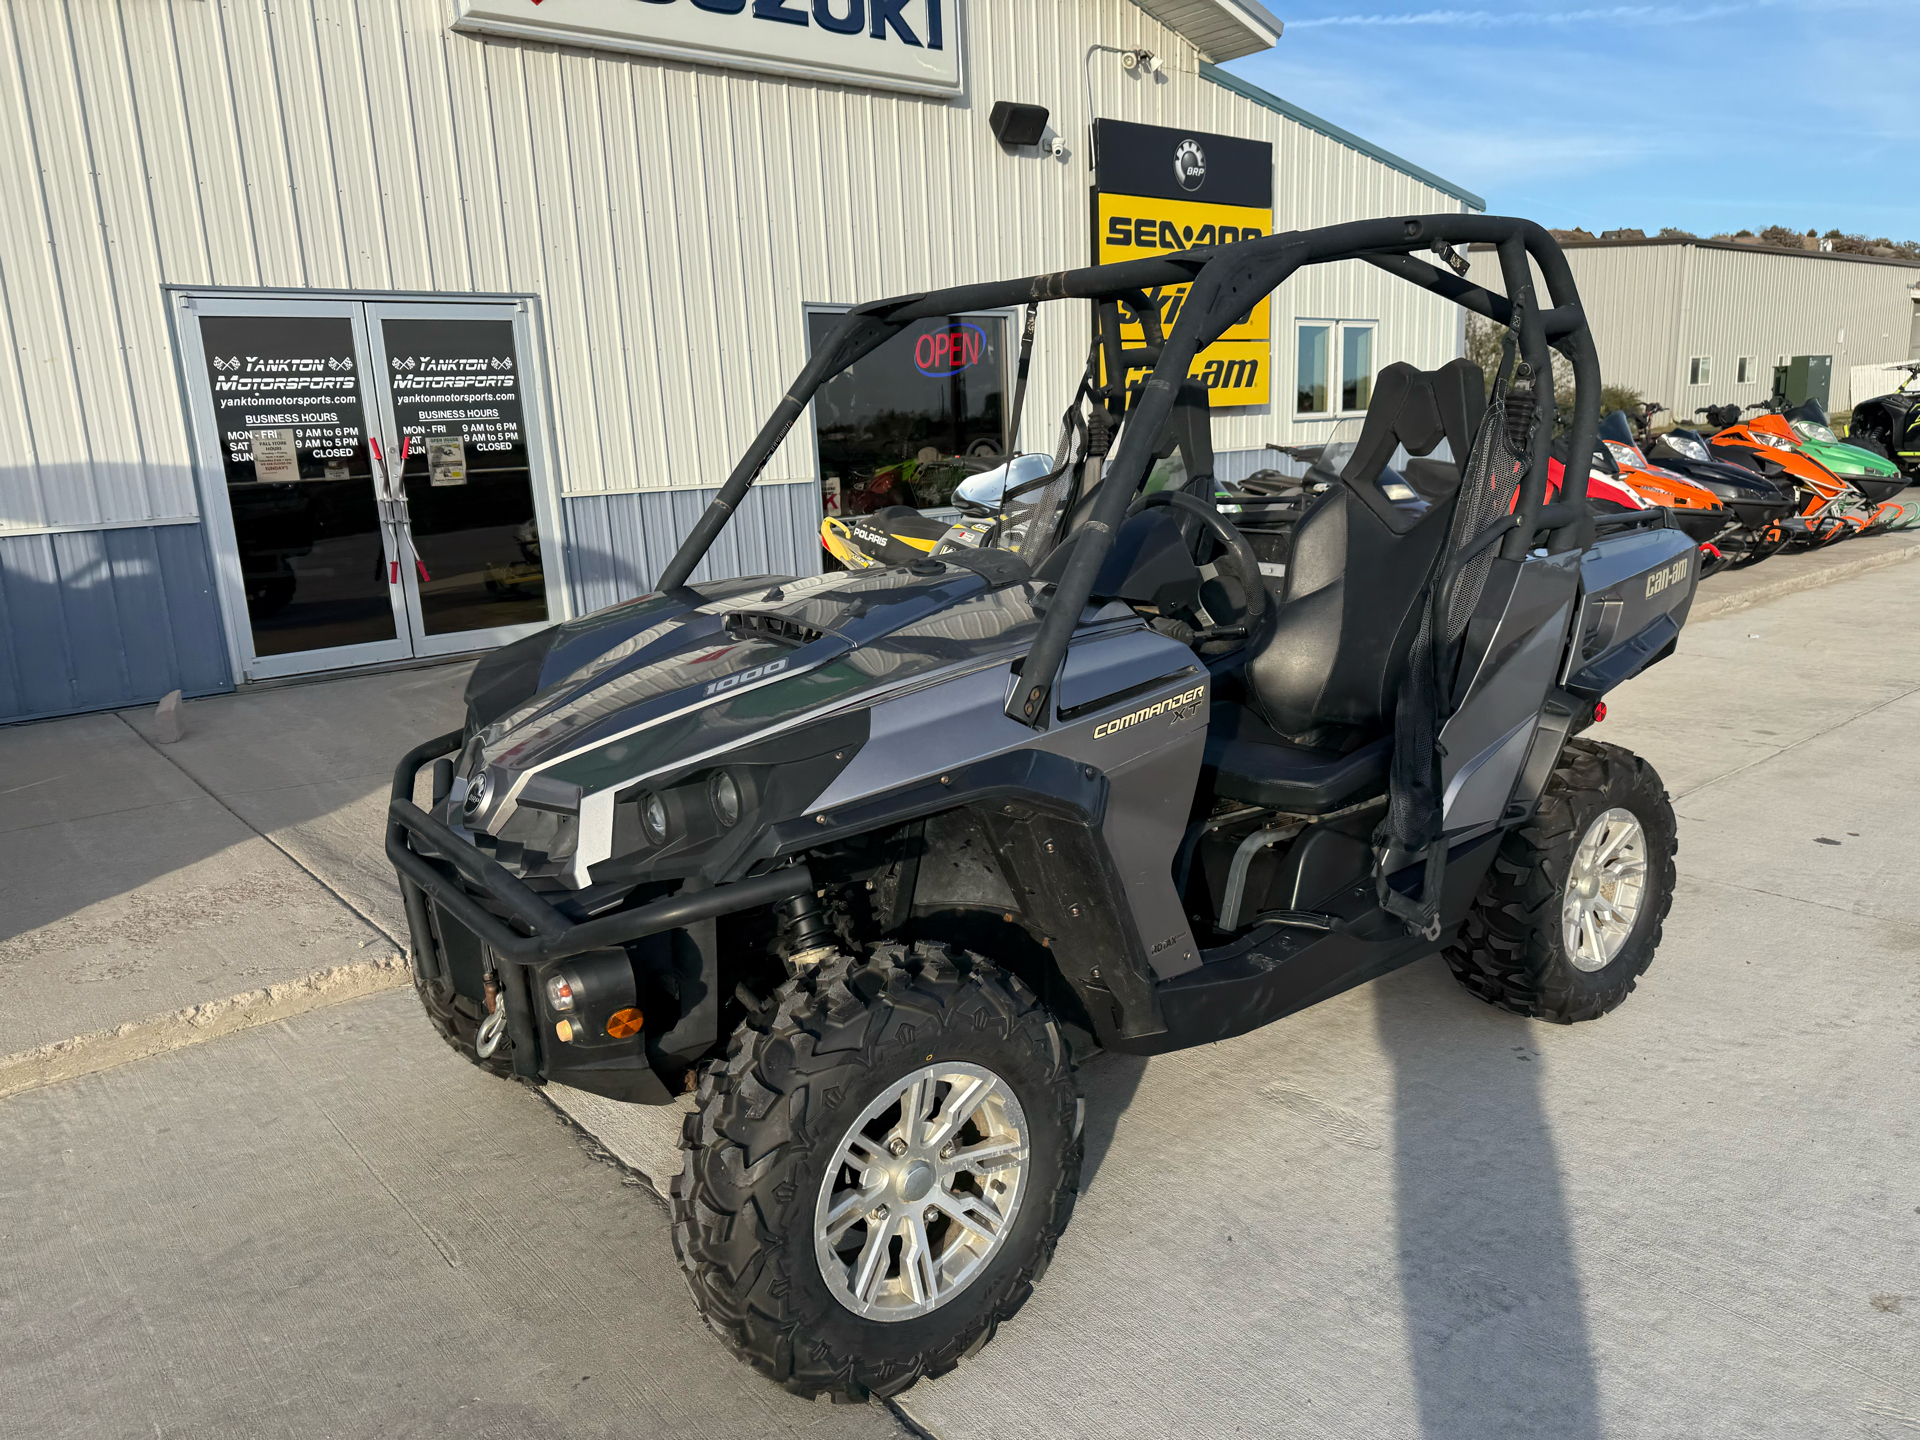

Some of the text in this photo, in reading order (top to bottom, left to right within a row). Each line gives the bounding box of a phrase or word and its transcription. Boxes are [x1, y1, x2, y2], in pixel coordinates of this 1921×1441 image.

[640, 0, 943, 50] UKI
[1186, 166, 1205, 177] BRP
[915, 332, 979, 368] OPEN
[245, 356, 325, 372] YANKTON
[419, 356, 488, 371] YANKTON
[215, 375, 355, 391] MOTORSPORTS
[393, 374, 514, 389] MOTORSPORTS
[220, 395, 356, 409] yanktonmotorsports.com
[397, 393, 515, 405] yanktonmotorsports.com
[245, 412, 338, 424] BUSINESS HOURS
[418, 408, 499, 419] BUSINESS HOURS
[227, 431, 253, 440] MON
[260, 430, 278, 439] FRI
[295, 429, 303, 438] 9
[305, 429, 321, 437] AM
[323, 428, 333, 437] to
[335, 427, 342, 436] 6
[343, 427, 359, 436] PM
[403, 426, 426, 435] MON
[432, 425, 447, 433] FRI
[462, 424, 468, 432] 9
[470, 423, 484, 432] AM
[486, 423, 495, 431] to
[496, 422, 502, 431] 6
[503, 422, 517, 430] PM
[229, 437, 358, 451] SAT 9 AM to 5 PM
[409, 432, 518, 444] AT 9 AM to 5 PM
[476, 442, 513, 451] CLOSED
[231, 448, 354, 462] SUN CLOSED
[853, 527, 888, 547] POLARIS
[1645, 558, 1688, 599] can-am
[705, 659, 787, 696] 1000
[1093, 685, 1205, 740] COMMANDER
[1169, 701, 1202, 726] XT
